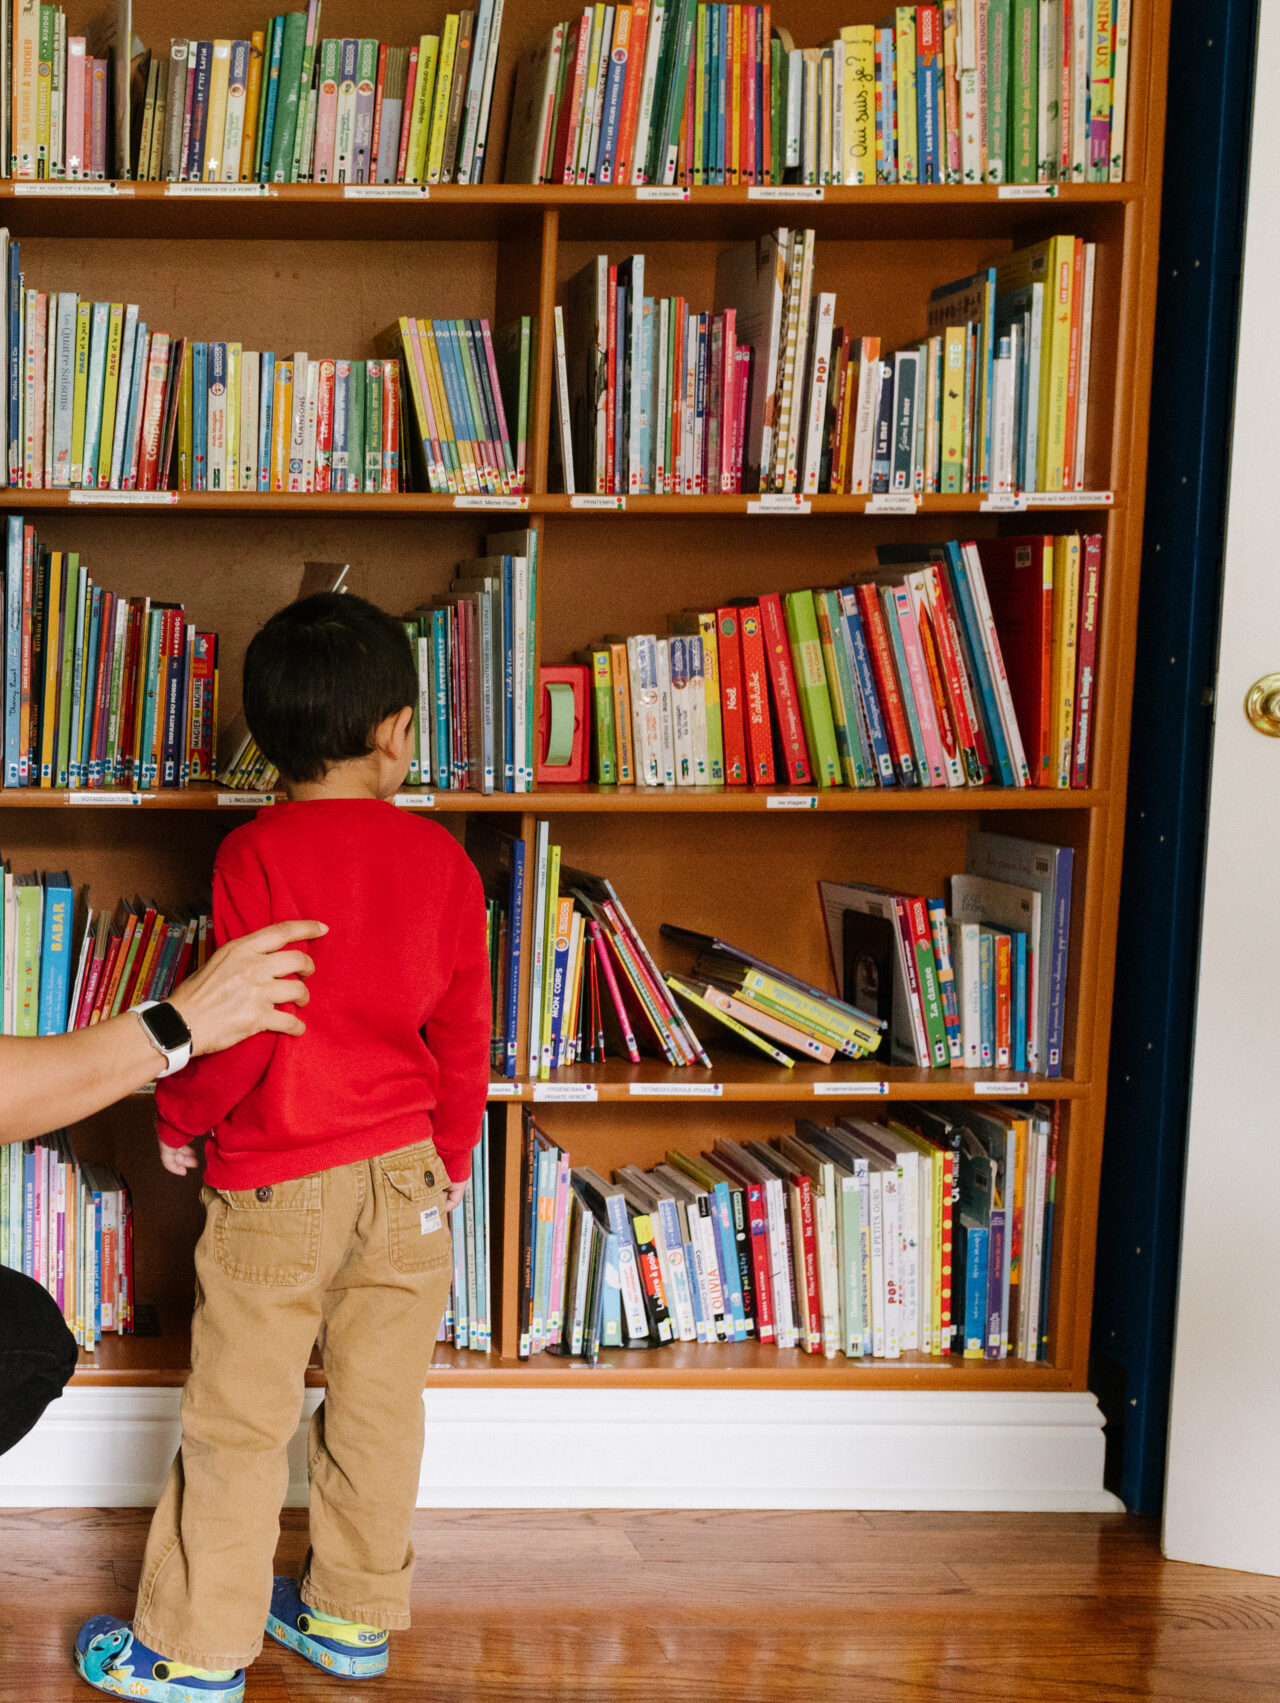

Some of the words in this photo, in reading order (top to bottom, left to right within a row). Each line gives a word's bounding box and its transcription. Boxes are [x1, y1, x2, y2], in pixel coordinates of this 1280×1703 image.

[850, 129, 867, 157] Qui
[727, 687, 737, 709] Noël
[52, 902, 64, 951] BABAR
[708, 1268, 724, 1310] OLIVIA
